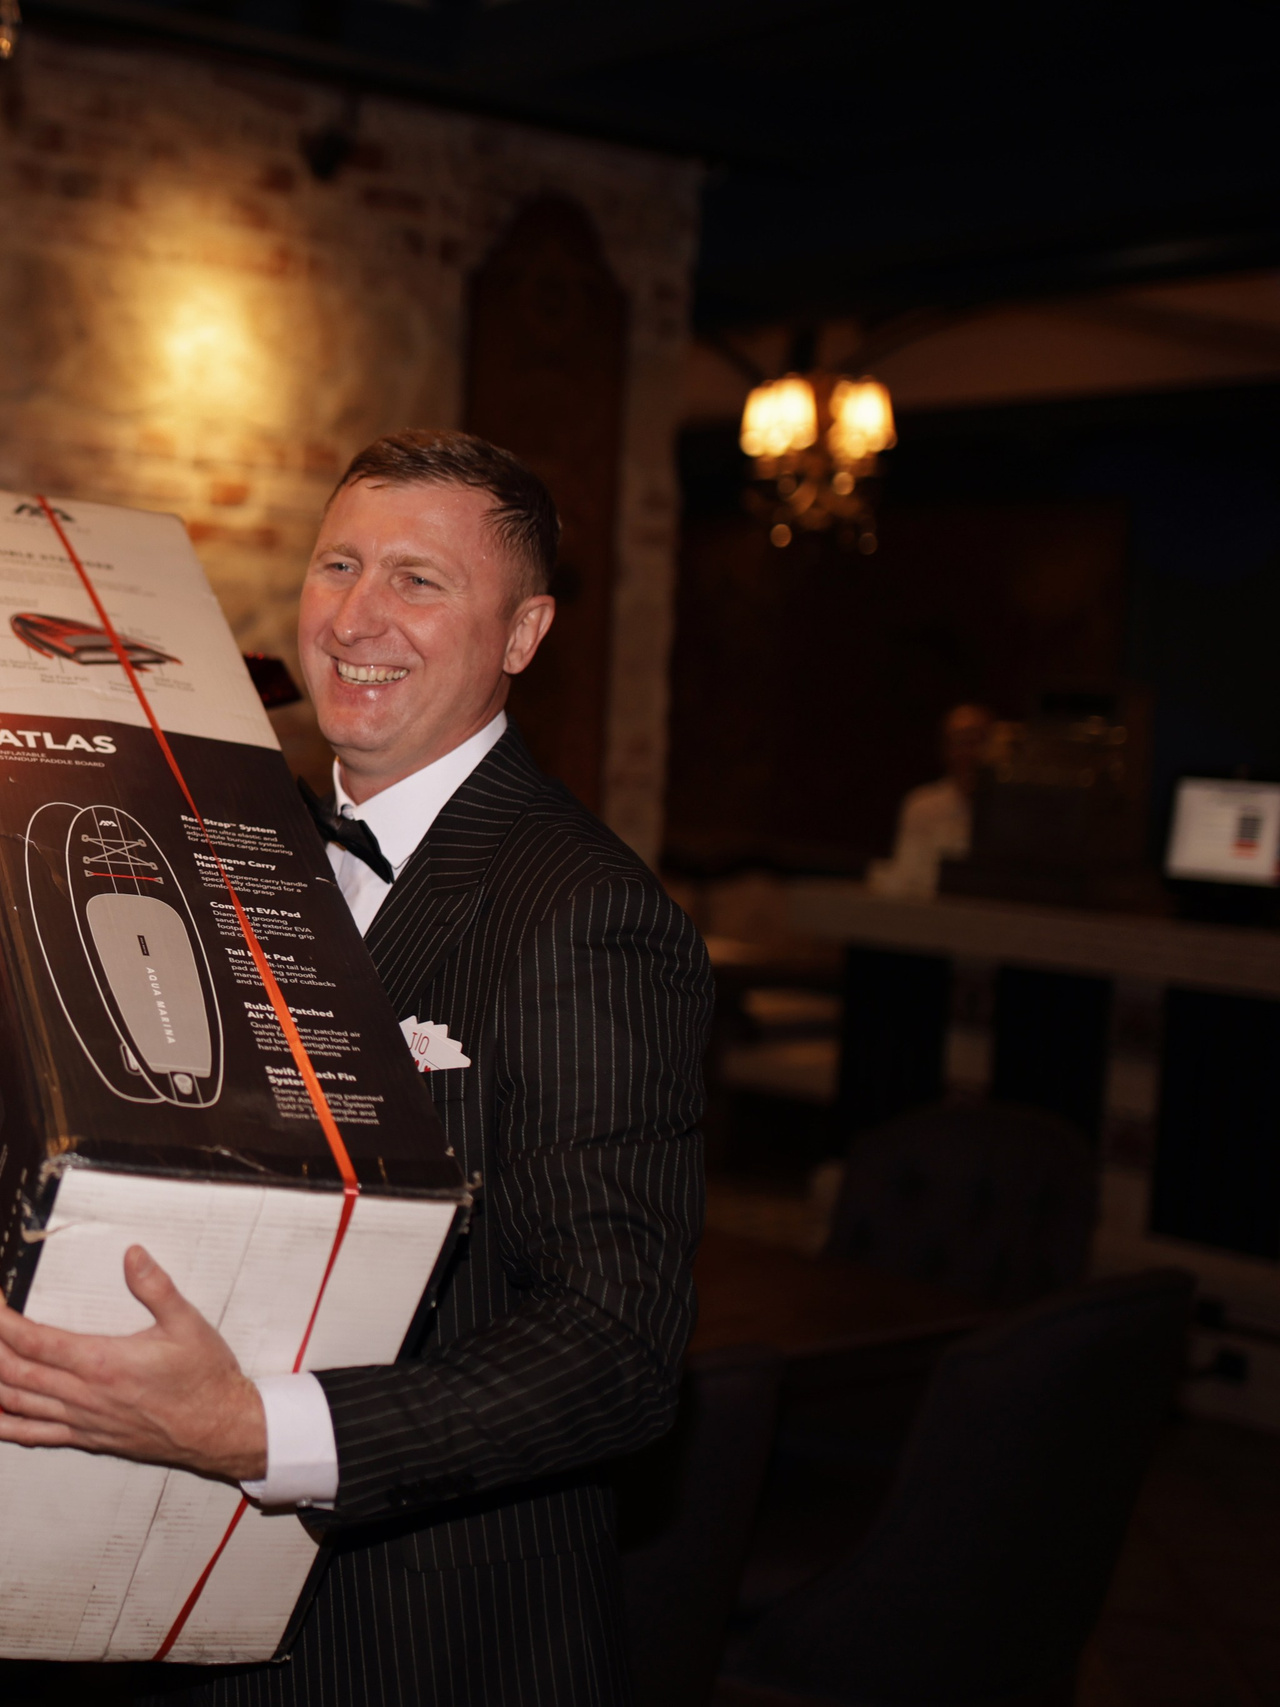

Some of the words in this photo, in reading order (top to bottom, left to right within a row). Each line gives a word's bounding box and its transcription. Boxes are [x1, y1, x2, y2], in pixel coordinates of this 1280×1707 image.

[0, 755, 38, 763] STANDUP
[40, 758, 73, 766] PADDLE
[75, 760, 105, 768] BOARD
[184, 824, 218, 834] Premum
[219, 829, 236, 837] ultra
[238, 832, 261, 841] elastic
[263, 835, 278, 843] and
[239, 824, 277, 835] System
[200, 839, 236, 848] efortless
[236, 843, 259, 851] cargo
[260, 847, 294, 856] securing
[227, 835, 257, 845] bungee
[258, 840, 285, 849] system
[247, 860, 276, 871] Carry
[199, 869, 219, 877] Solid
[260, 877, 280, 886] carry
[280, 879, 308, 888] handle
[245, 881, 282, 892] designed
[252, 887, 276, 897] grasp
[210, 901, 255, 913] Comort
[256, 907, 280, 916] EVA
[280, 910, 301, 919] Pad
[251, 915, 288, 926] grooving
[262, 923, 293, 932] exterior
[237, 932, 270, 941] cofort
[264, 929, 297, 938] ultimate
[298, 933, 316, 941] grip
[225, 947, 246, 957] Tail
[247, 950, 272, 960] Kk
[273, 953, 295, 962] Pad
[228, 957, 255, 966] Bonus
[286, 962, 299, 970] tail
[300, 965, 317, 973] kick
[231, 965, 248, 973] pad
[285, 971, 317, 979] smooth
[236, 978, 253, 986] and
[299, 980, 337, 988] cutbacks
[146, 966, 162, 996] AQUA
[156, 1000, 176, 1044] MARINA
[244, 1001, 275, 1012] Rubb
[288, 1006, 335, 1018] Patched
[247, 1011, 264, 1019] Air
[250, 1021, 281, 1031] Quality
[313, 1028, 349, 1038] patched
[253, 1029, 276, 1037] valve
[330, 1036, 350, 1044] look
[257, 1043, 283, 1052] harsh
[415, 1033, 430, 1055] 10
[265, 1065, 297, 1077] Swift
[337, 1072, 357, 1082] Fin
[343, 1093, 385, 1103] patented
[359, 1110, 377, 1118] and
